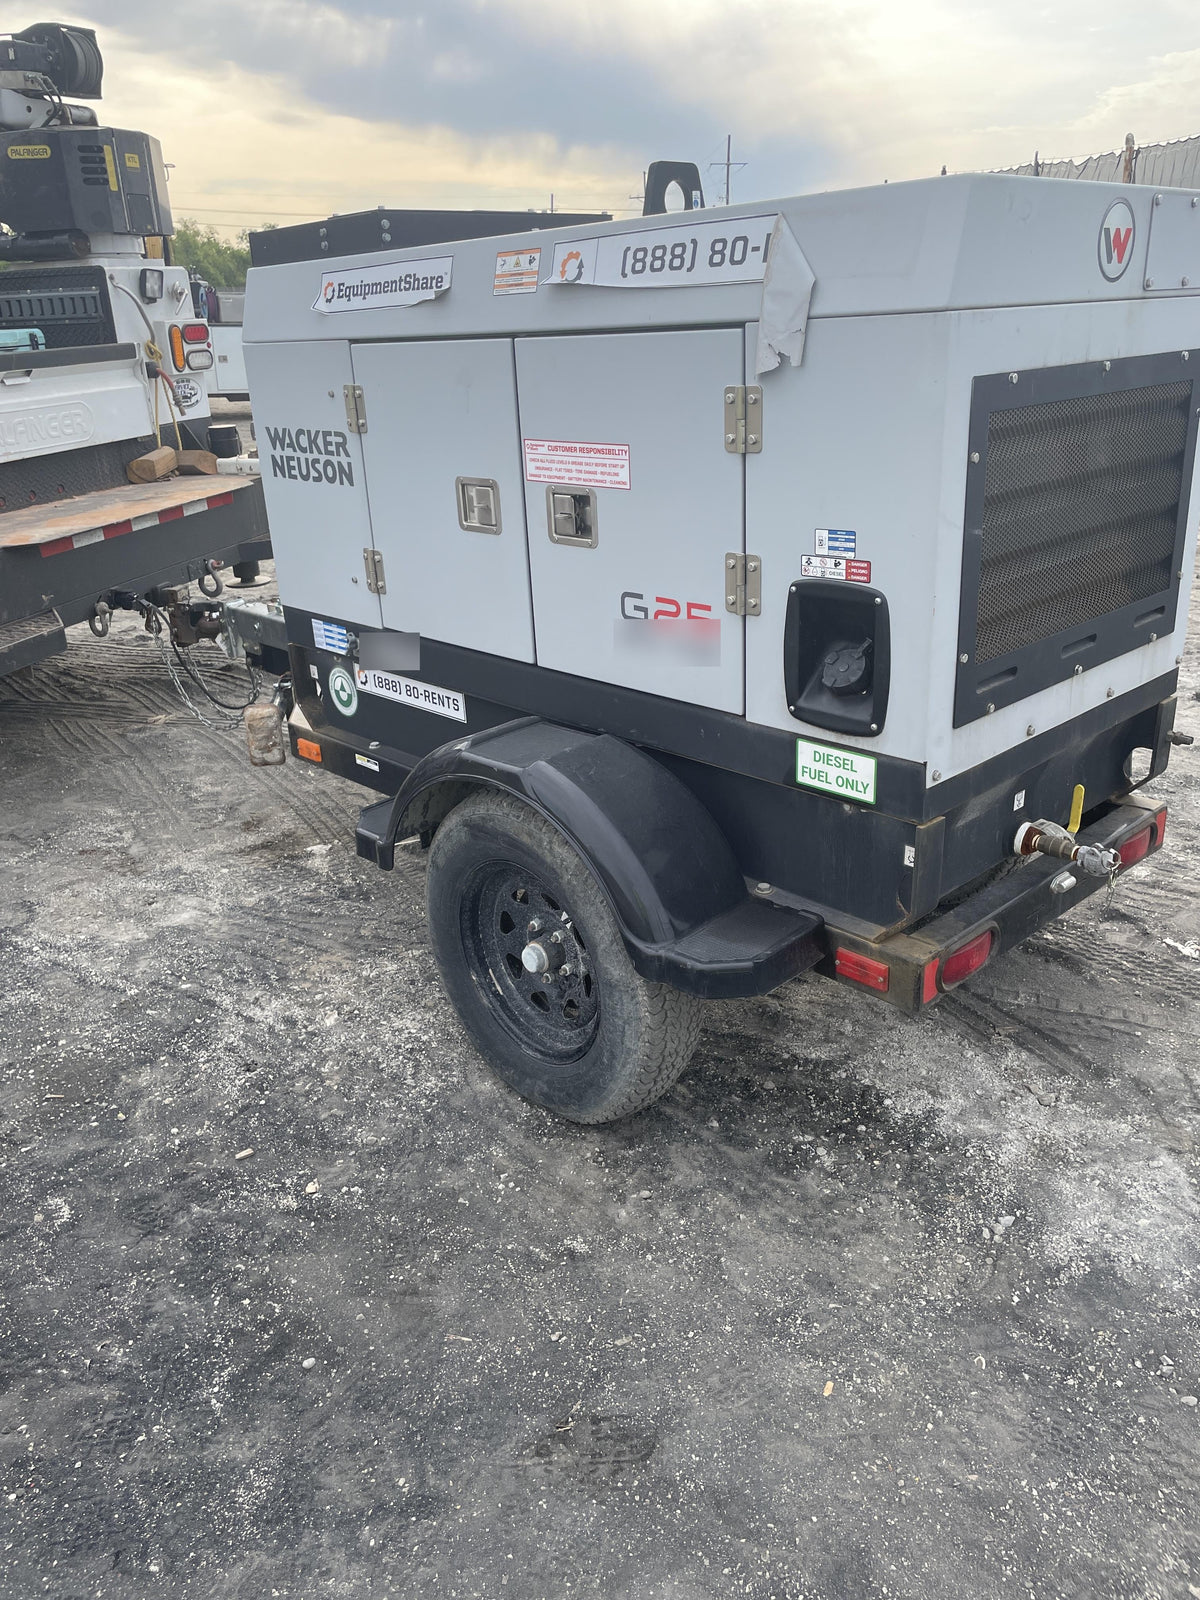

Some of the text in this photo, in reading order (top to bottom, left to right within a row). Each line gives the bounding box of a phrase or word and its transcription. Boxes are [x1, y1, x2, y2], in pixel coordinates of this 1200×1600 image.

[10, 147, 48, 157] PALFINGER
[621, 232, 772, 278] (888) 80-
[265, 426, 351, 458] WACKER
[547, 445, 628, 457] CUSTOMER RESPONSIBILITY
[271, 454, 355, 487] NEUSON
[373, 673, 402, 695] (888)
[405, 684, 460, 712] 80-RENTS
[813, 750, 858, 773] DIESEL
[801, 765, 870, 795] FUEL ONLY
